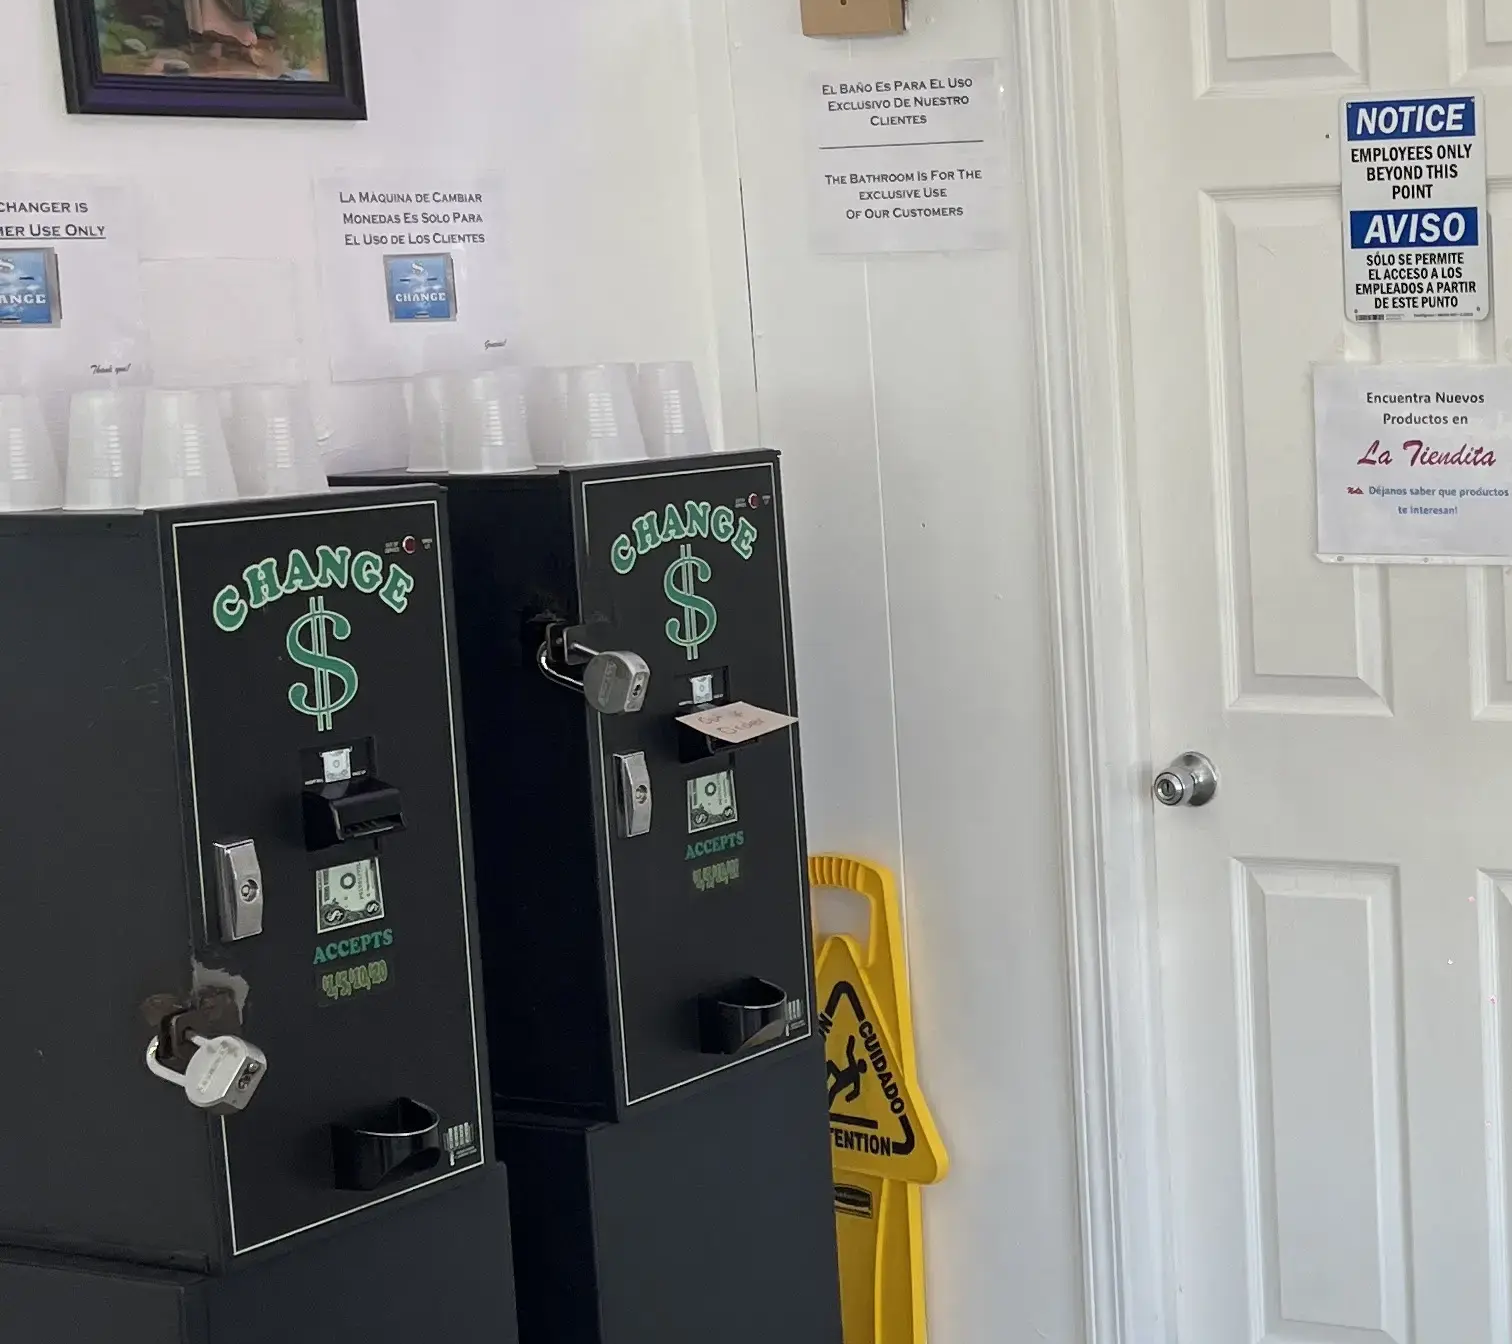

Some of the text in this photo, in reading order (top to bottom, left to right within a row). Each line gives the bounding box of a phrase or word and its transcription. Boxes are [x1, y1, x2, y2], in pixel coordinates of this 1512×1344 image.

[823, 78, 973, 96] EL BAÑO ES PARA EL USO
[828, 96, 969, 112] EXCLUSIVO DE NUESTRO
[870, 115, 927, 126] CLIENTES
[1356, 103, 1466, 135] NOTICE
[1351, 144, 1472, 162] EMPLOYEES ONLY
[825, 169, 982, 185] THE BATHROOM IS FOR THE
[1367, 164, 1458, 181] BEYOND THIS
[339, 192, 356, 203] LA
[415, 193, 429, 203] DE
[432, 192, 482, 203] CAMBIAR
[859, 188, 947, 200] EXCLUSIVE USE
[1392, 184, 1433, 200] POINT
[75, 203, 88, 213] IS
[846, 207, 963, 219] OF OUR CUSTOMERS
[343, 212, 483, 224] MONEDAS ES SOLO PARA
[29, 224, 60, 236] USE
[65, 224, 105, 236] ONLY
[1364, 212, 1466, 244] AVISO
[345, 232, 485, 245] EL USO DE LOS CLIENTES
[1366, 251, 1464, 266] SÓLO SE PERMITE
[1369, 267, 1462, 280] EL ACCESO A LOS
[1356, 281, 1476, 295] EMPLEADOS A PARTIR
[396, 292, 446, 302] CHANGE
[1374, 296, 1458, 309] DE ESTE PUNTO
[91, 364, 113, 374] Thank
[1367, 392, 1484, 404] Encuentra Nuevos
[1383, 413, 1468, 425] Productos en
[1357, 439, 1496, 466] La Tiendita
[1369, 486, 1509, 498] Déjanos saber que productos
[1398, 506, 1458, 515] te interesan!
[611, 500, 757, 574] CHANGE
[213, 545, 414, 631] CHANGE
[685, 831, 744, 860] ACCEPTS
[313, 929, 393, 964] ACCEPTS
[859, 1021, 905, 1115] CUIDADO
